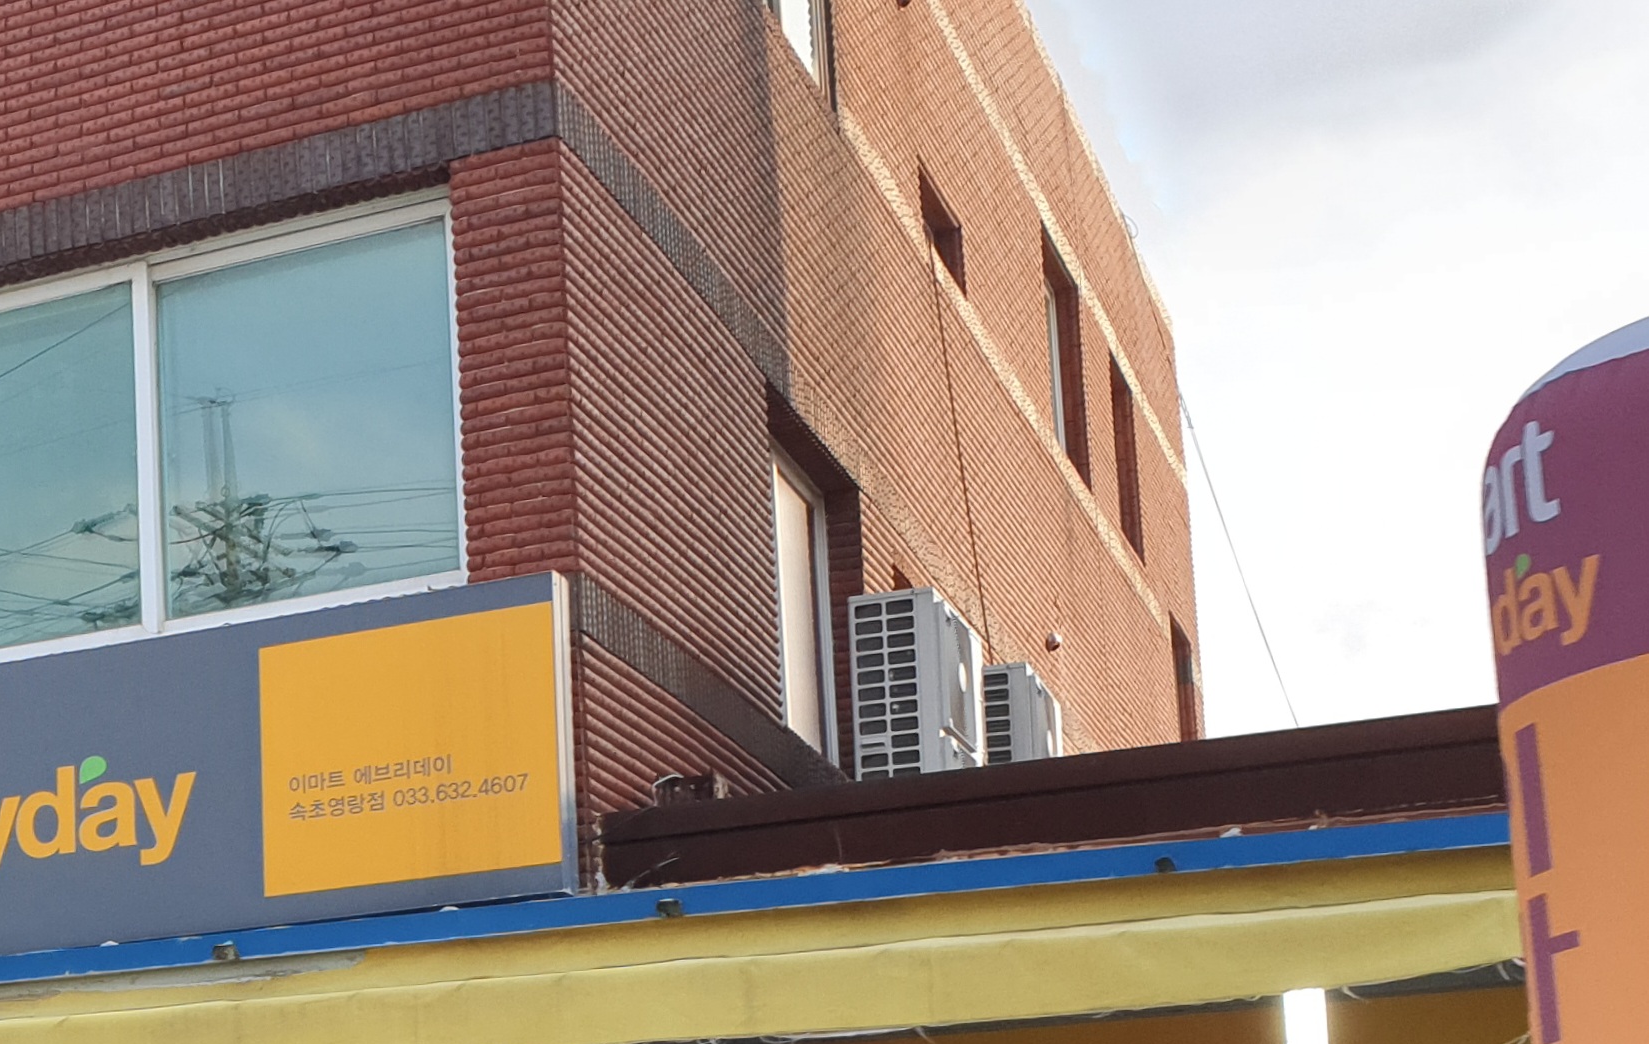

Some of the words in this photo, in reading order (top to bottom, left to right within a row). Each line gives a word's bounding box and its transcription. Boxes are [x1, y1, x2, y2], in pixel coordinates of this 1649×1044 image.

[288, 769, 346, 794] 이마트
[353, 754, 452, 785] 에브리데이
[288, 791, 386, 821] 속초영랑점
[392, 772, 529, 807] 033.632.4607
